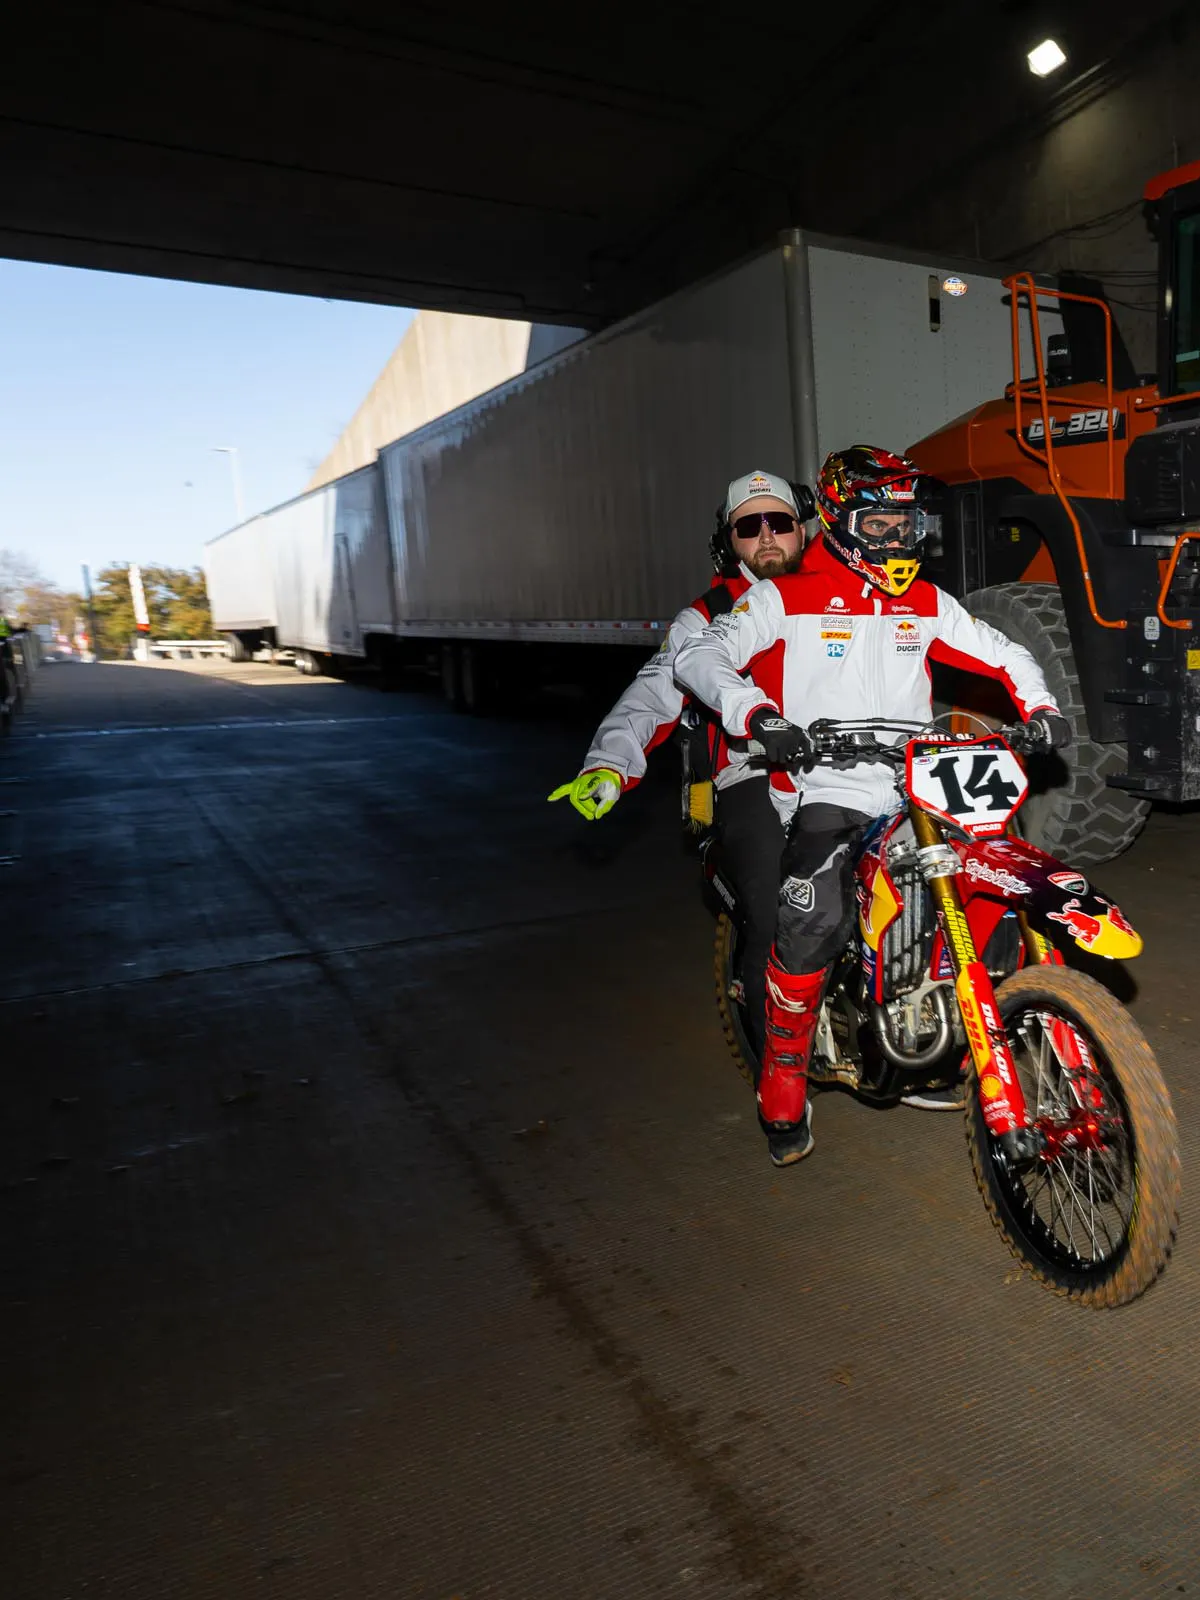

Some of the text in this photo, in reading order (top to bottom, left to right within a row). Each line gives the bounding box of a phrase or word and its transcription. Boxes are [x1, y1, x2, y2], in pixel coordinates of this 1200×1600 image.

[1028, 407, 1120, 440] DL 320
[895, 632, 920, 640] Red Bull
[827, 643, 845, 656] PPG
[928, 754, 1020, 816] 14
[972, 823, 1002, 833] DUCATI
[958, 998, 984, 1056] DHL
